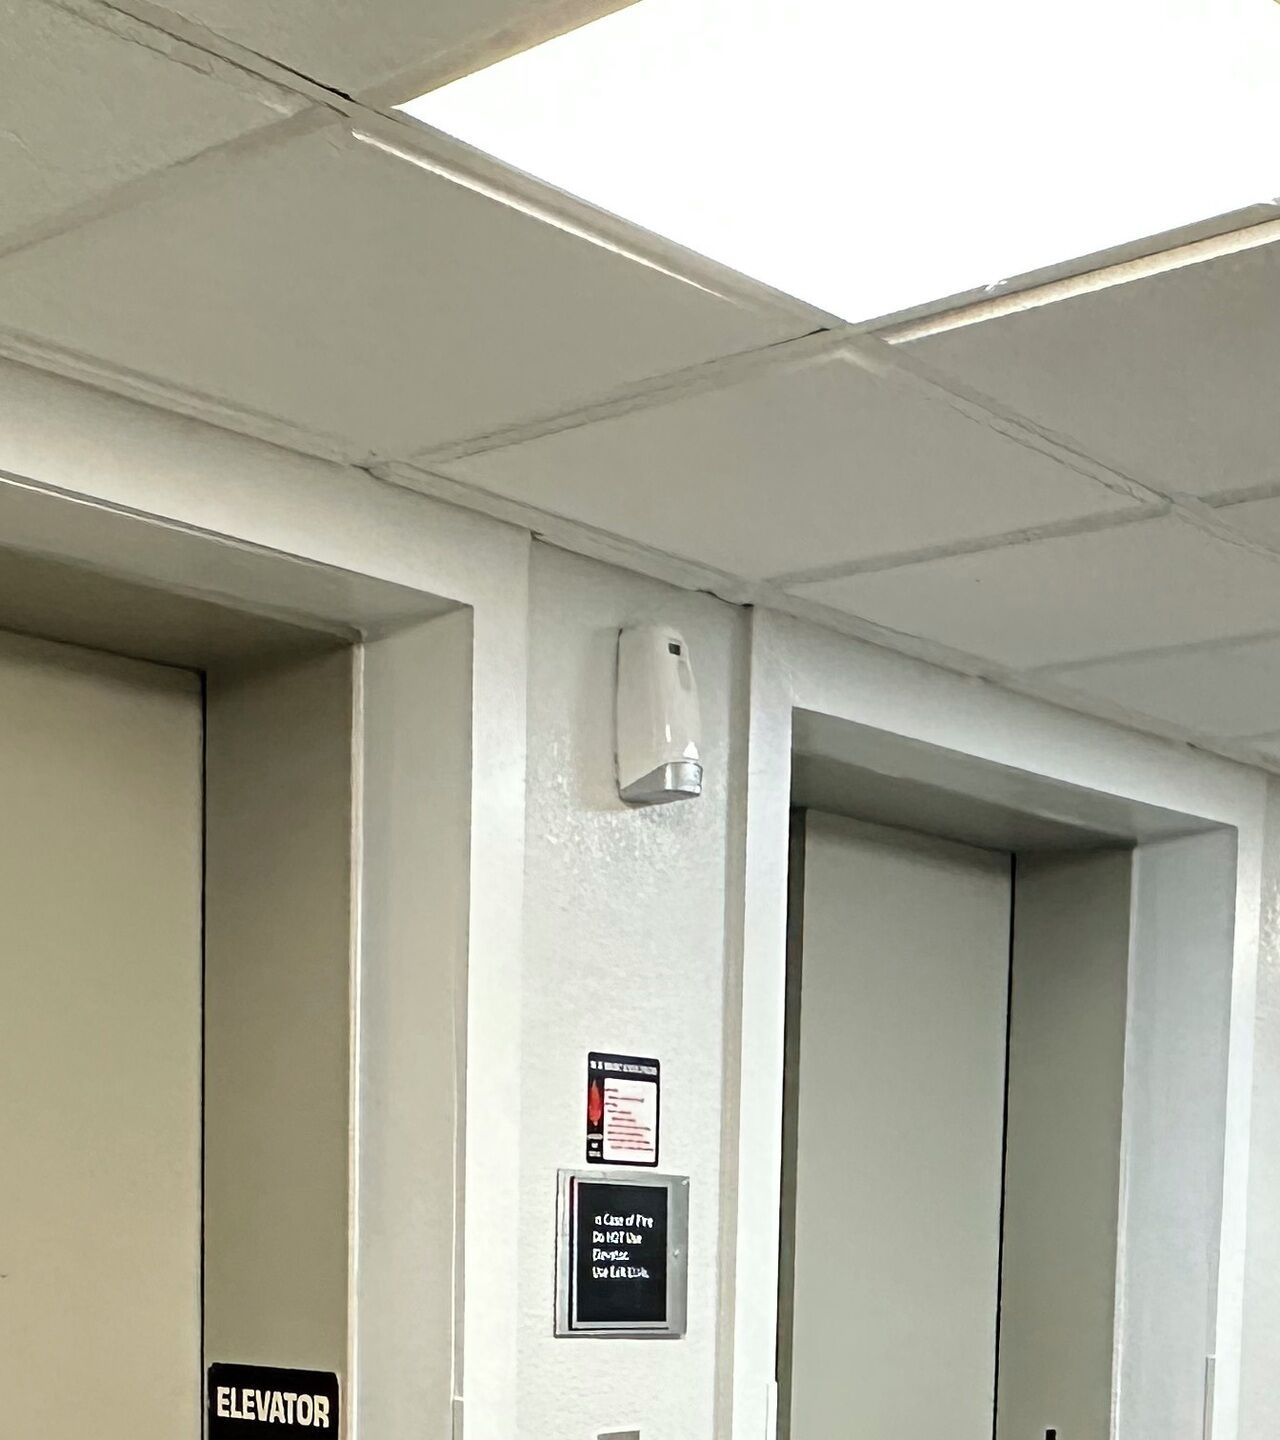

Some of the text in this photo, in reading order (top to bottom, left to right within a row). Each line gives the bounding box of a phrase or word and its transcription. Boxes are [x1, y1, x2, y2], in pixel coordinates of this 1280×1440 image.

[636, 1213, 654, 1228] Fire
[592, 1230, 605, 1243] Do
[216, 1386, 330, 1428] ELEVATOR
